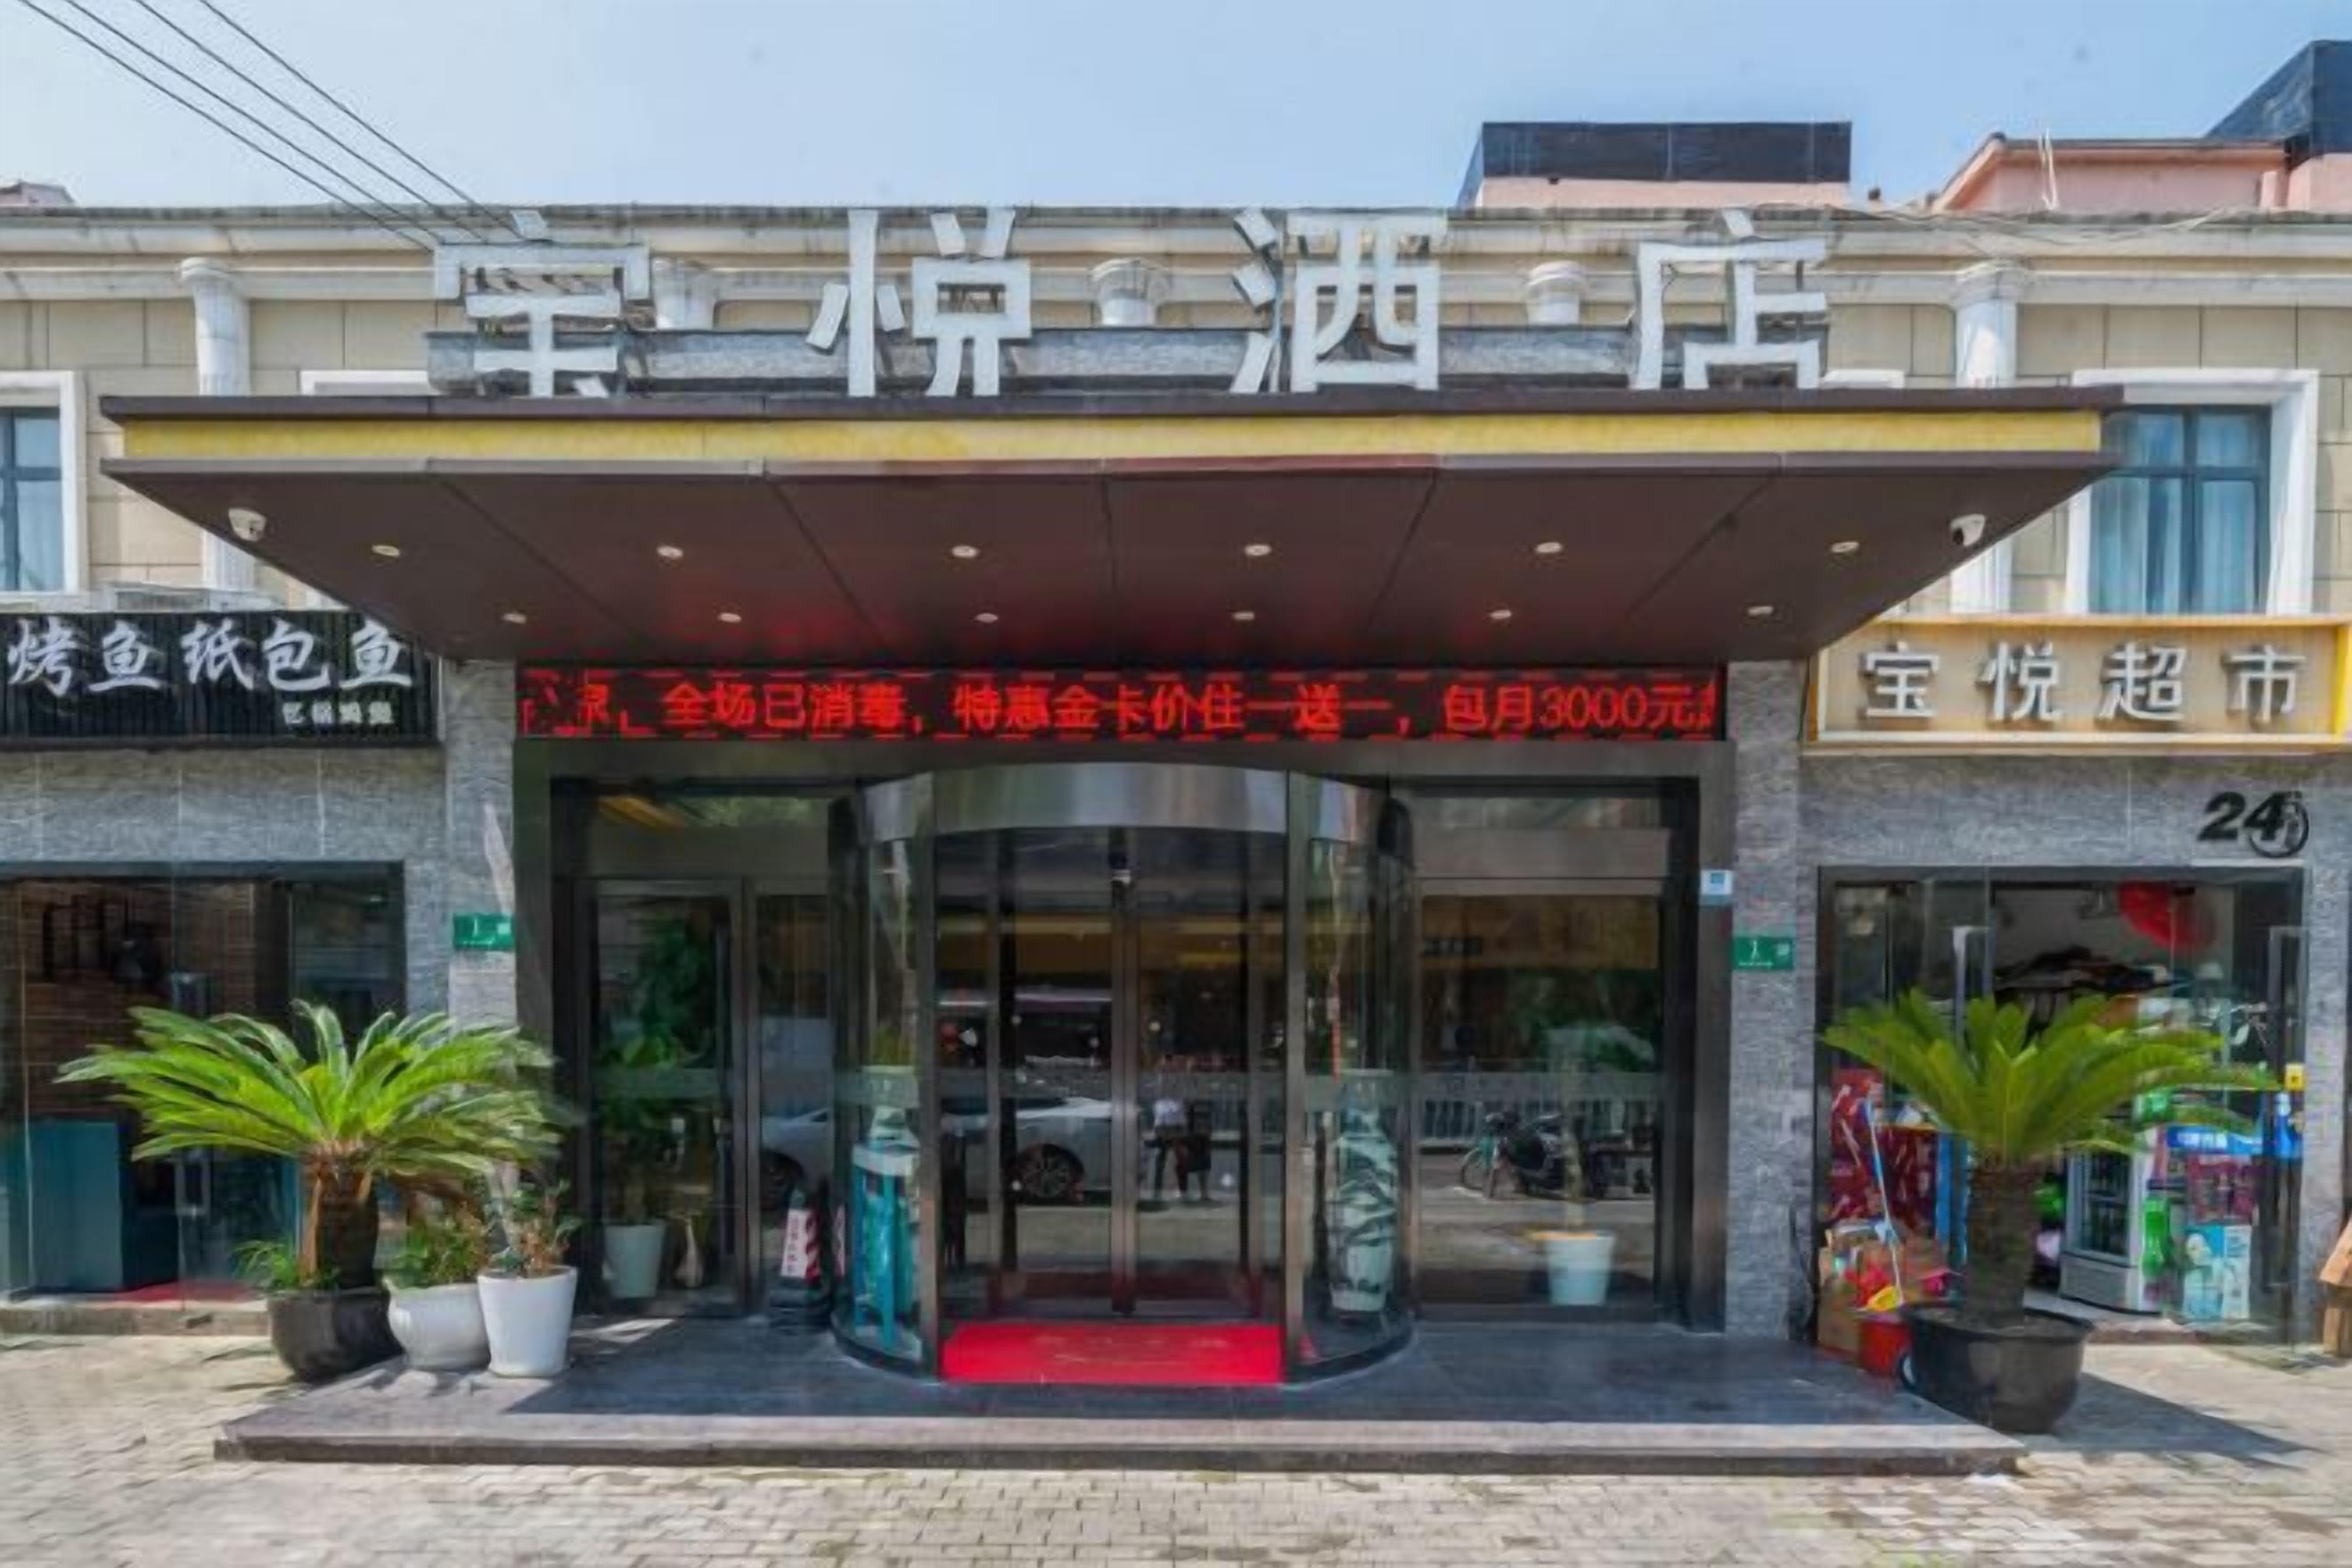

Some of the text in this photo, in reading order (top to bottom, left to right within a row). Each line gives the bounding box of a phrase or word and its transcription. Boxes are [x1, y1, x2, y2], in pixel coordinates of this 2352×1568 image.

[433, 208, 1828, 397] 宝悦酒店
[7, 617, 413, 698] 烤鱼纸包鱼
[1864, 641, 2307, 723] 宝悦超市
